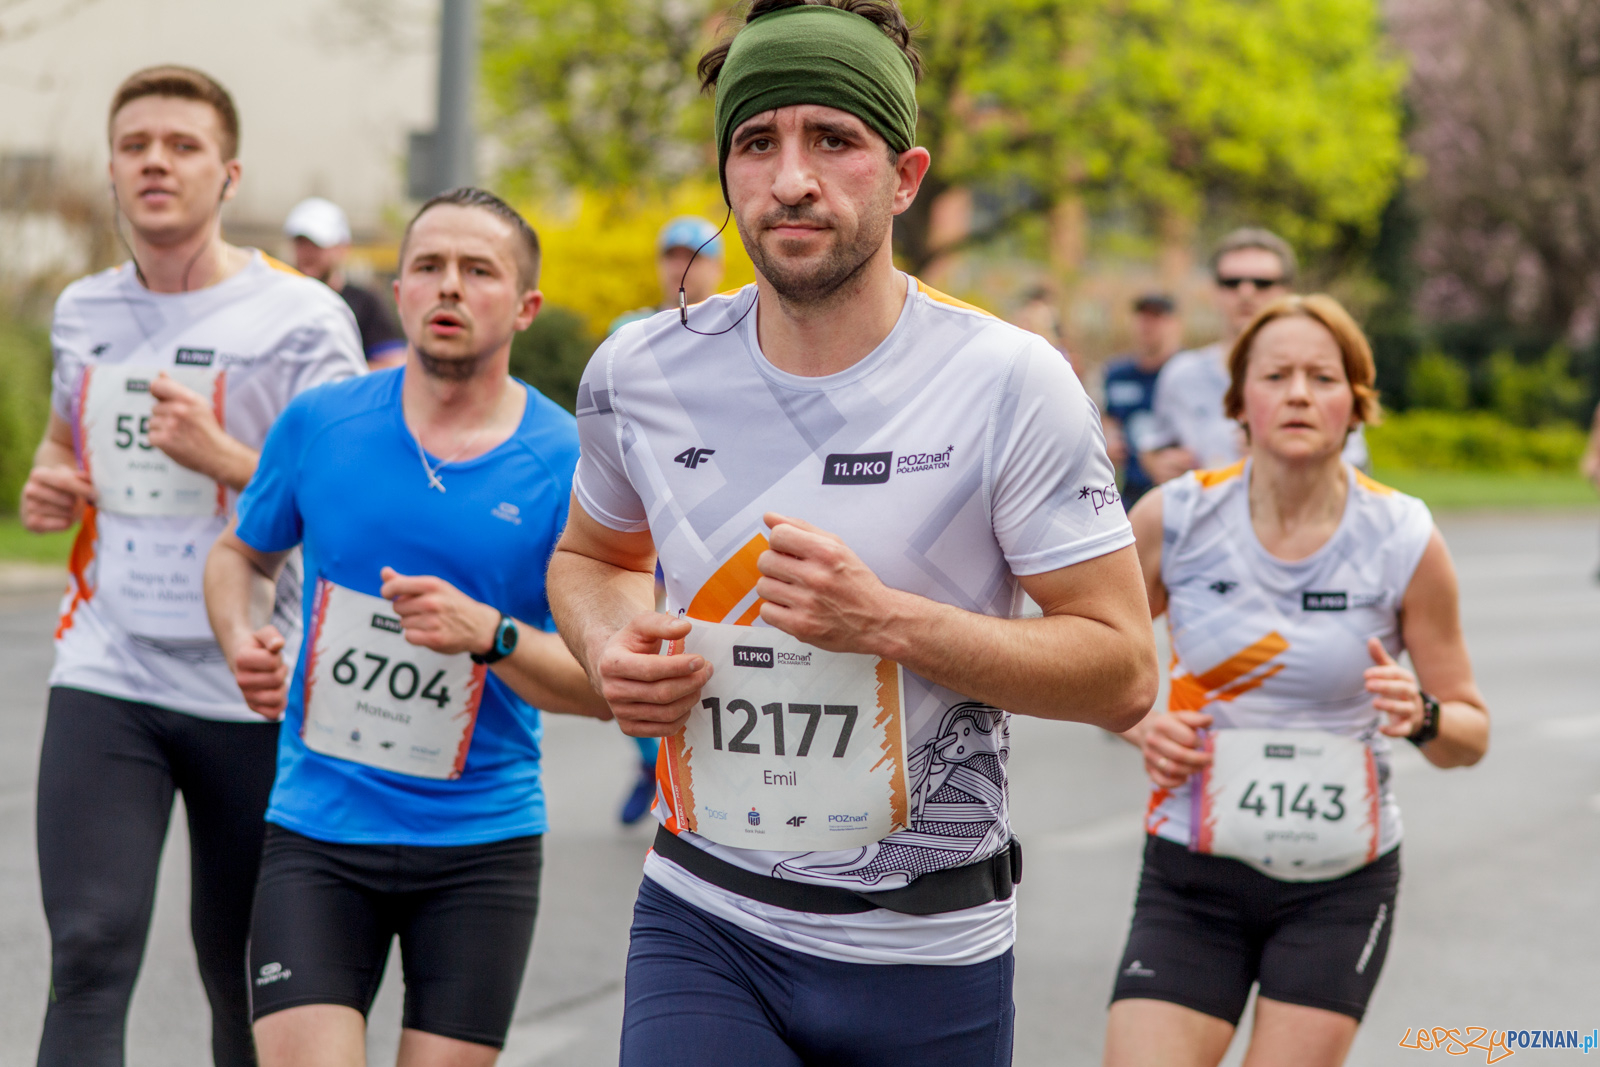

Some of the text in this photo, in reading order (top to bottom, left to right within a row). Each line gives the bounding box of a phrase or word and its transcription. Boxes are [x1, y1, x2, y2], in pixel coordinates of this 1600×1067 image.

[115, 414, 153, 450] 55
[673, 446, 716, 470] 4F
[896, 461, 950, 475] PÓŁMARATON
[332, 649, 452, 709] 6704
[356, 700, 412, 724] Mateusz
[701, 696, 859, 758] 12177
[763, 769, 797, 786] Emil
[1238, 780, 1346, 821] 4143
[786, 816, 808, 827] 4F
